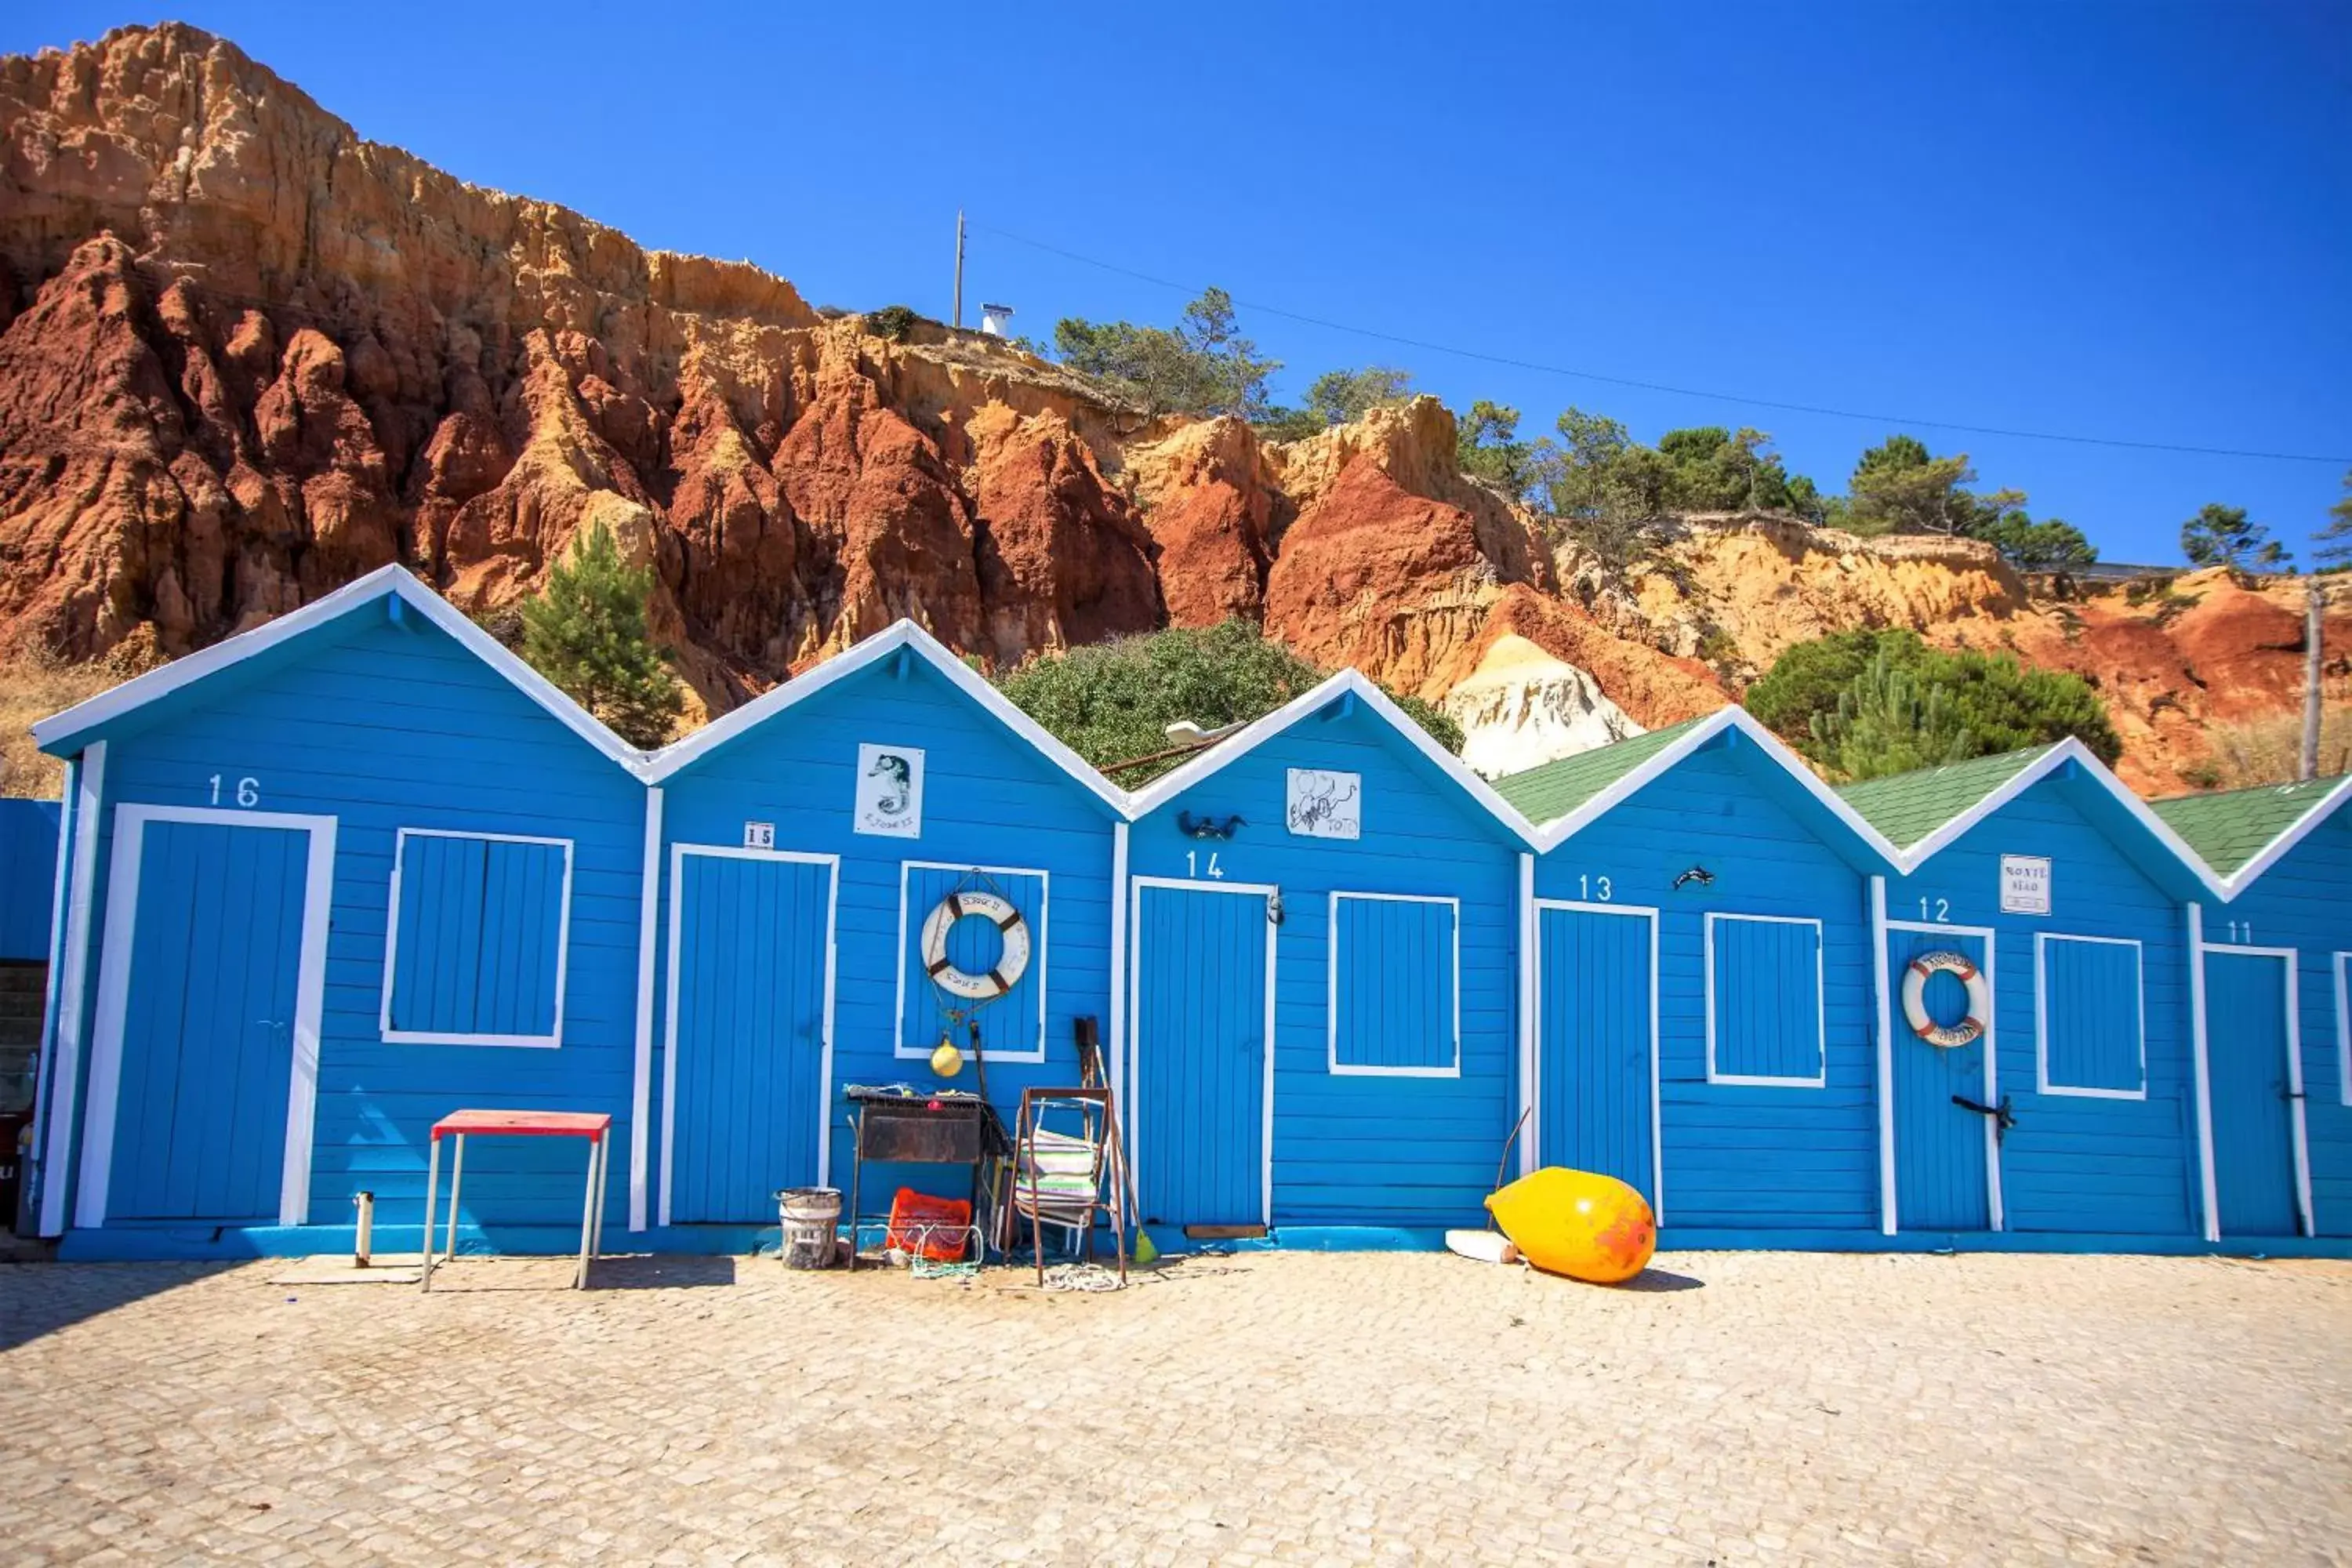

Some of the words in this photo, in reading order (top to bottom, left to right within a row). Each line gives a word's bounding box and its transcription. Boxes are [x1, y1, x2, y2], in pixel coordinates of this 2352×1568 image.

[209, 774, 260, 807] 16
[749, 828, 771, 844] 15
[1186, 851, 1224, 879] 14
[1580, 874, 1611, 901] 13
[1919, 896, 1950, 922] 12
[2227, 920, 2251, 943] 11
